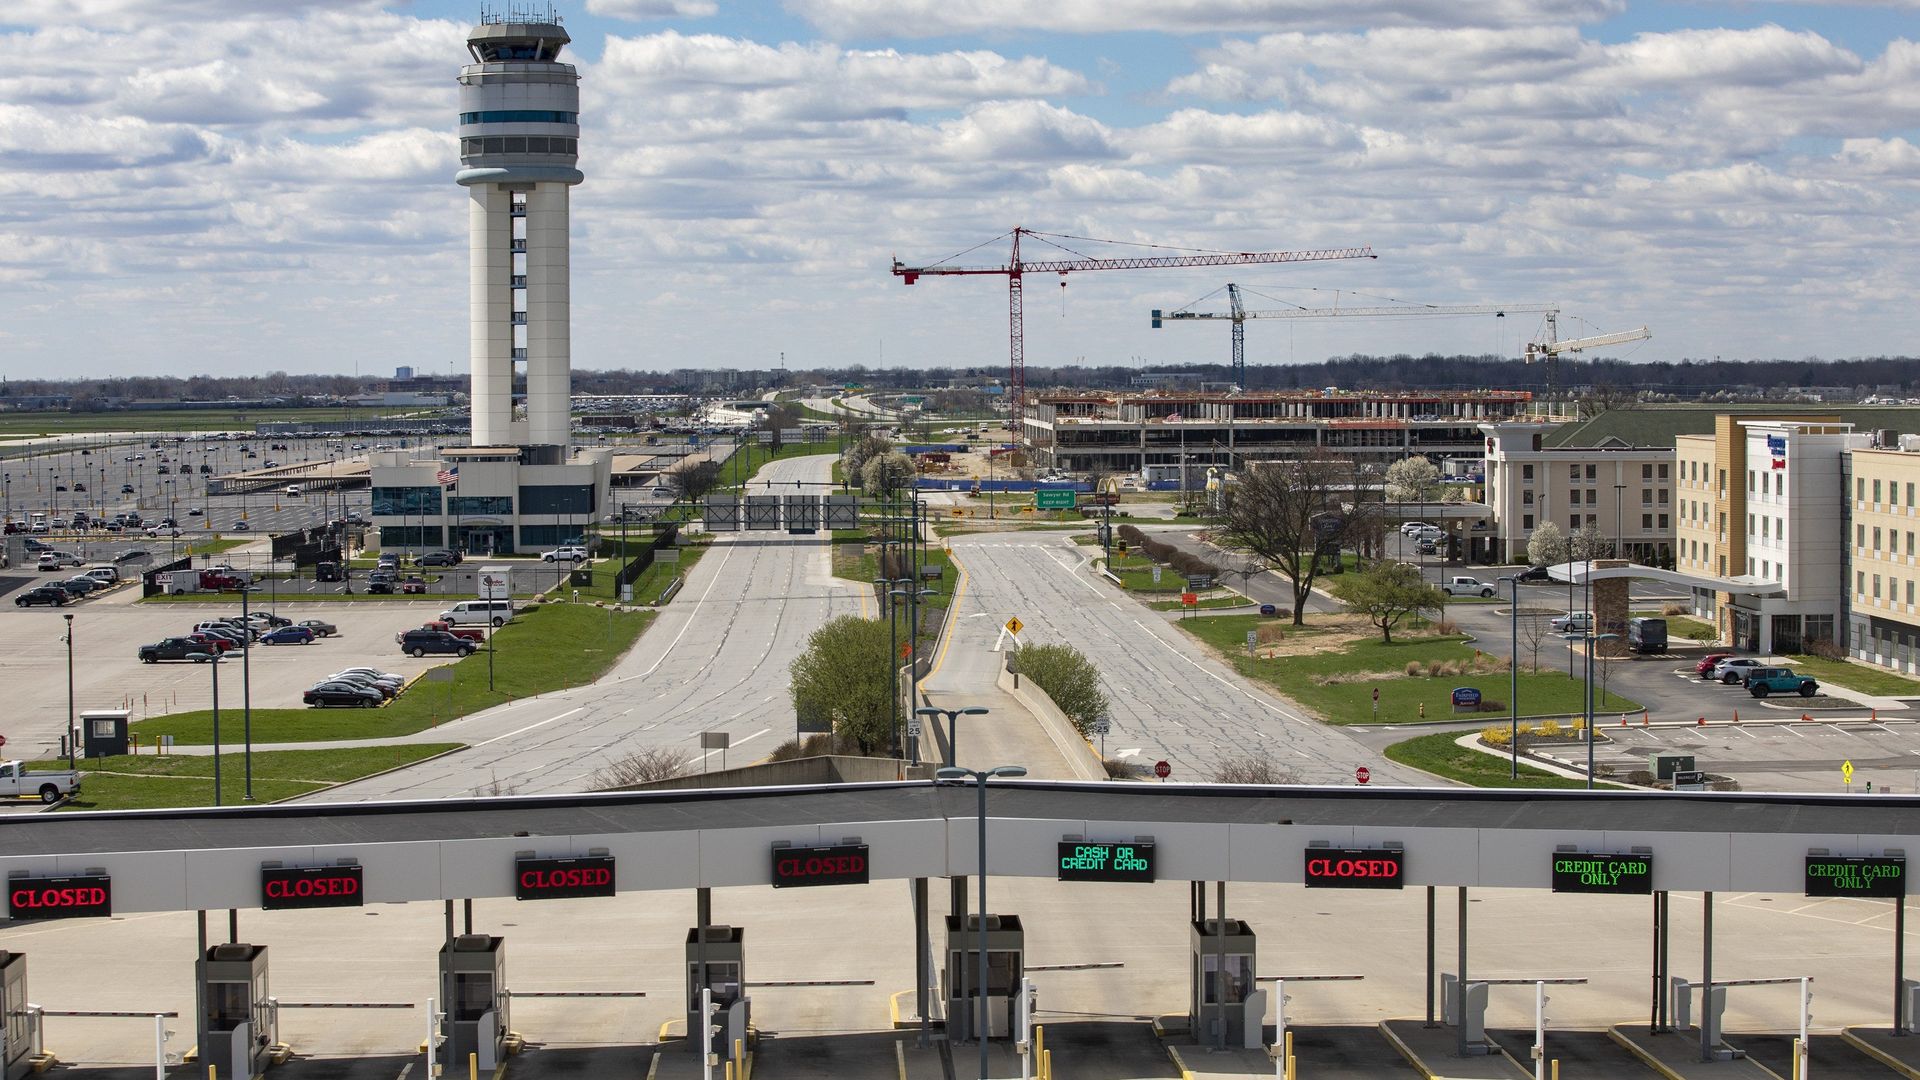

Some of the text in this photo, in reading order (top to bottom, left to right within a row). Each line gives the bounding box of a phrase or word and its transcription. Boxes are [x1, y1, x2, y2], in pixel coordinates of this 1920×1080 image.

[908, 727, 921, 735] 25
[1356, 771, 1369, 779] STOP
[1075, 847, 1134, 859] CASH OR
[777, 856, 865, 877] CLOSED
[1061, 858, 1148, 871] CREDIT CARD
[1308, 859, 1399, 878] CLOSED
[1555, 860, 1647, 875] CREDIT CARD
[1808, 864, 1901, 878] CREDIT CARD
[520, 868, 611, 888] CLOSED
[1580, 872, 1621, 886] ONLY
[1834, 876, 1874, 889] ONLY
[265, 877, 359, 898] CLOSED
[12, 887, 106, 908] CLOSED
